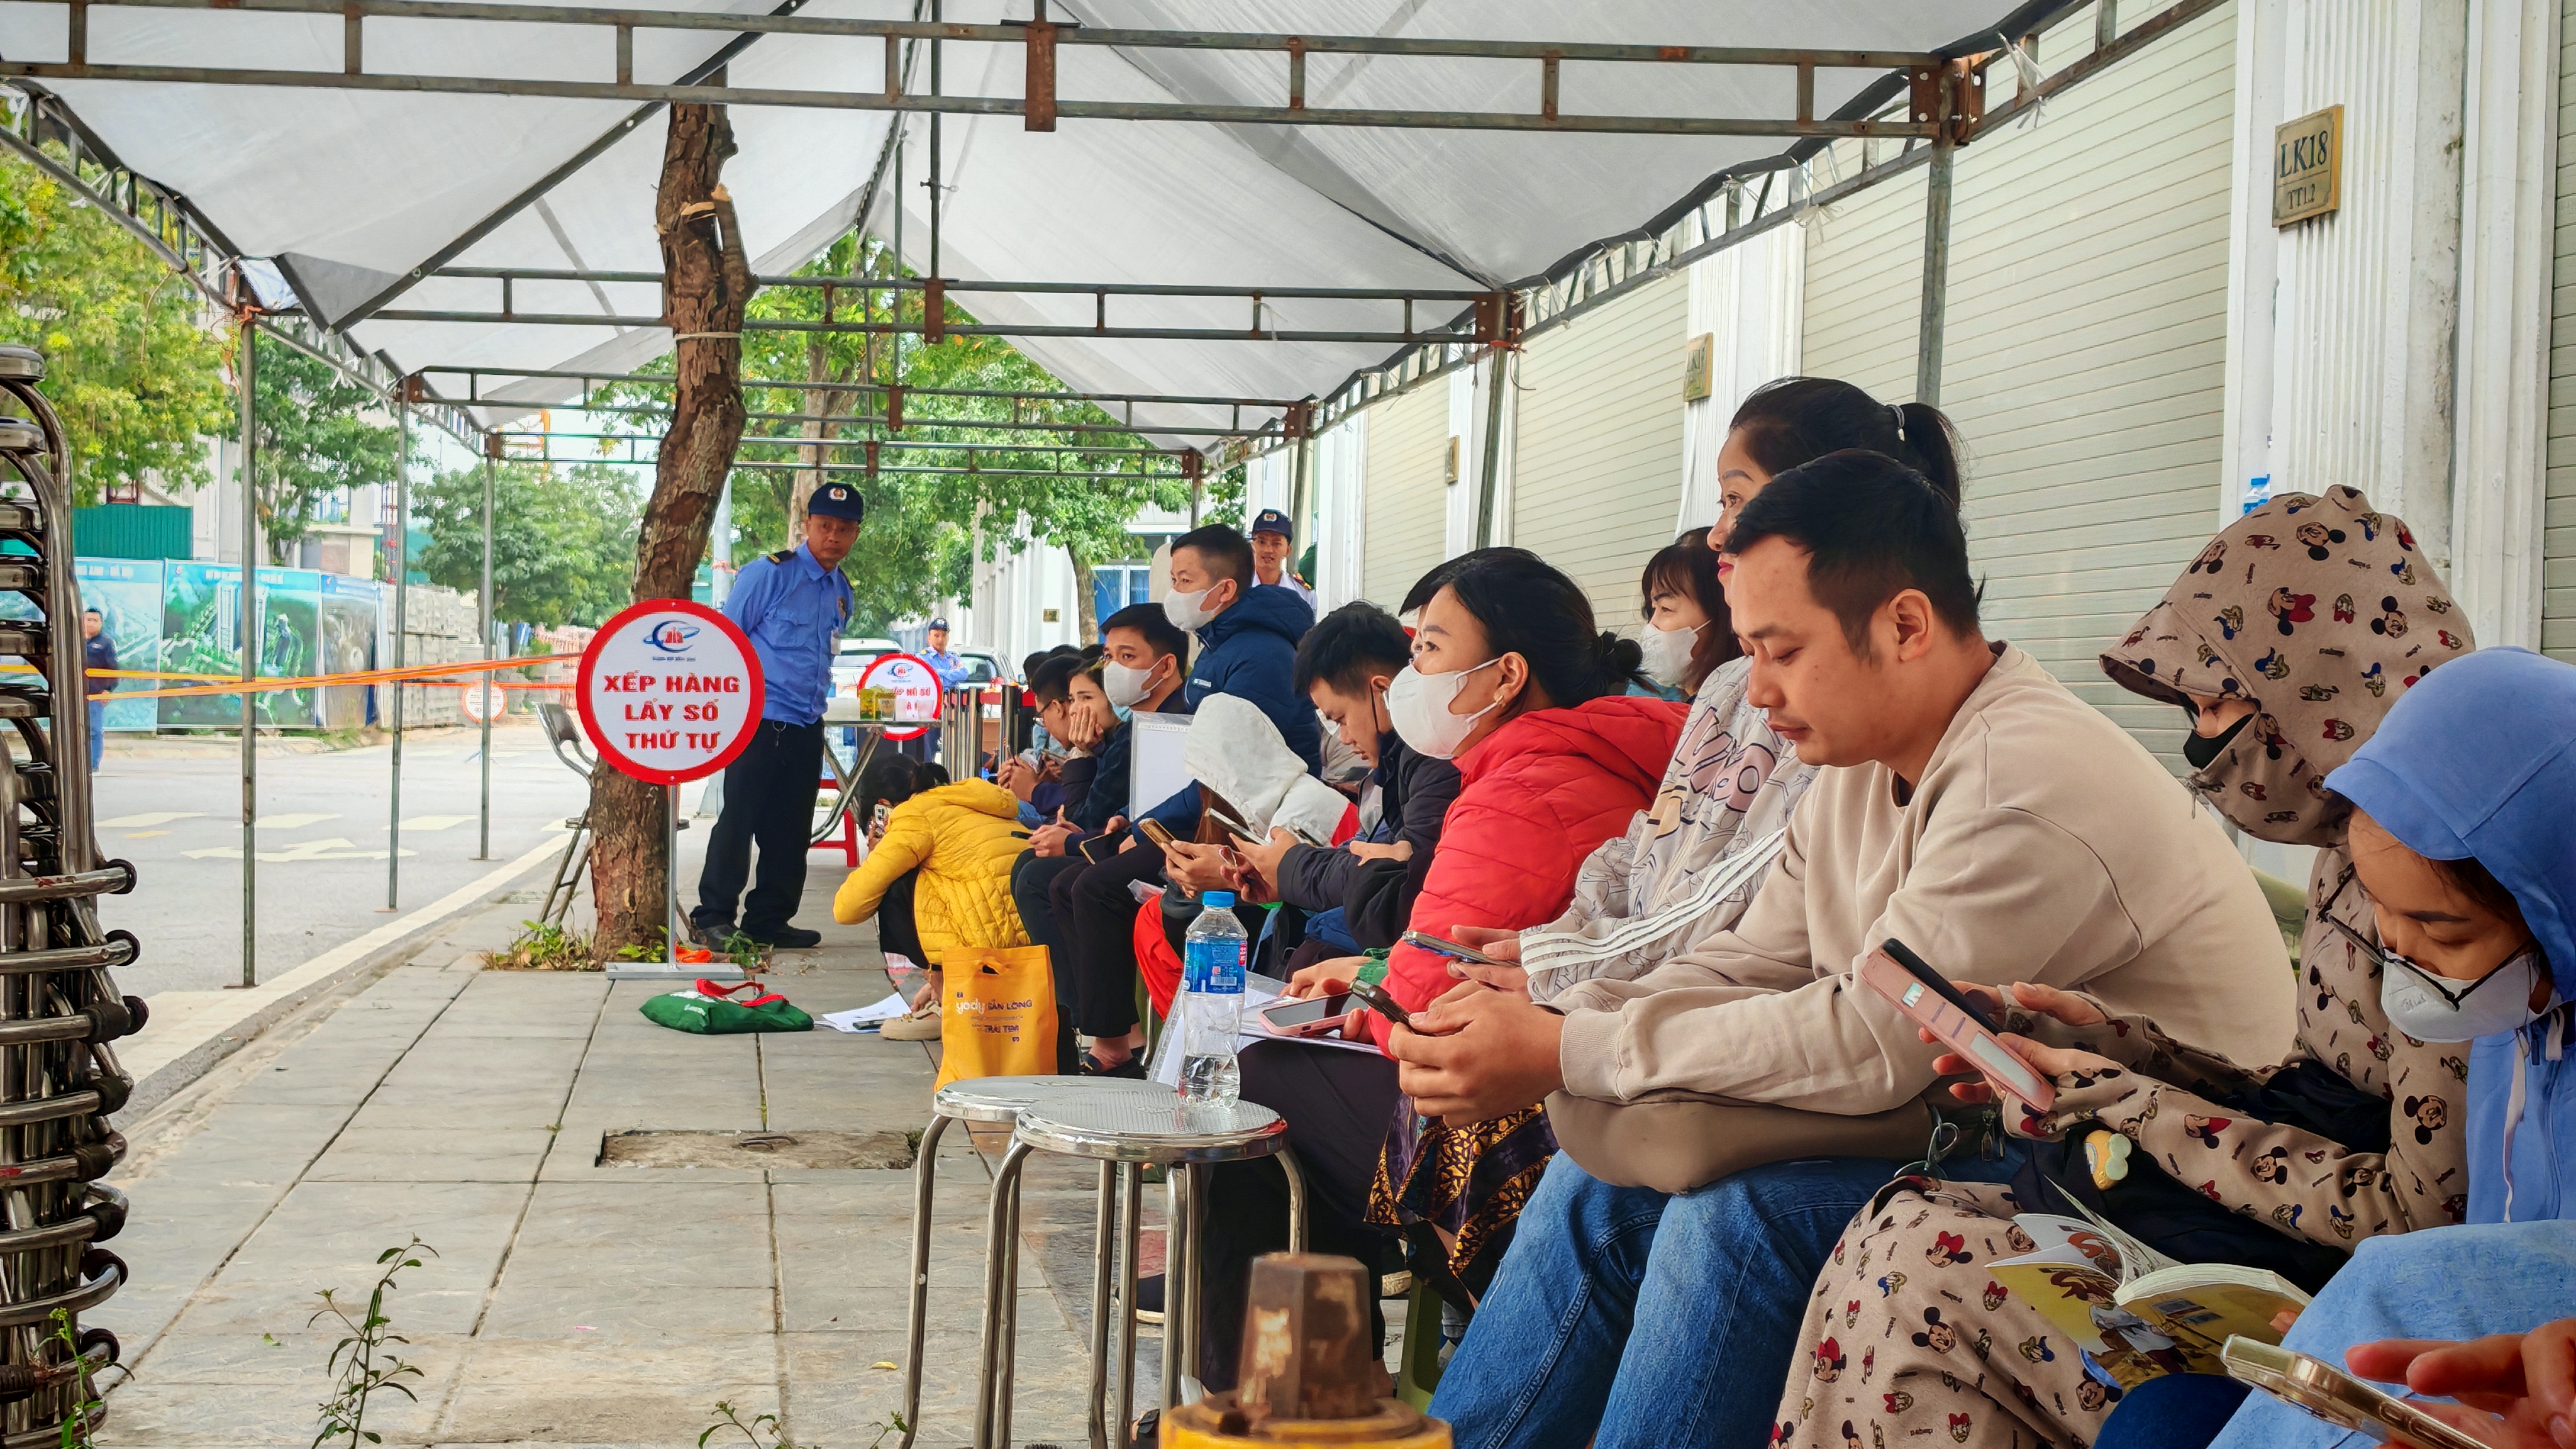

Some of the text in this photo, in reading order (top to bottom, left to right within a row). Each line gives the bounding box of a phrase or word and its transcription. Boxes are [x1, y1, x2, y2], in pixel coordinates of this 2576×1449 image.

[2280, 130, 2328, 179] LK18
[604, 670, 740, 692] XẾP HÀNG
[625, 697, 719, 721] LẤY SỐ
[625, 729, 722, 753] THỨ TỰ
[956, 997, 985, 1014] yody
